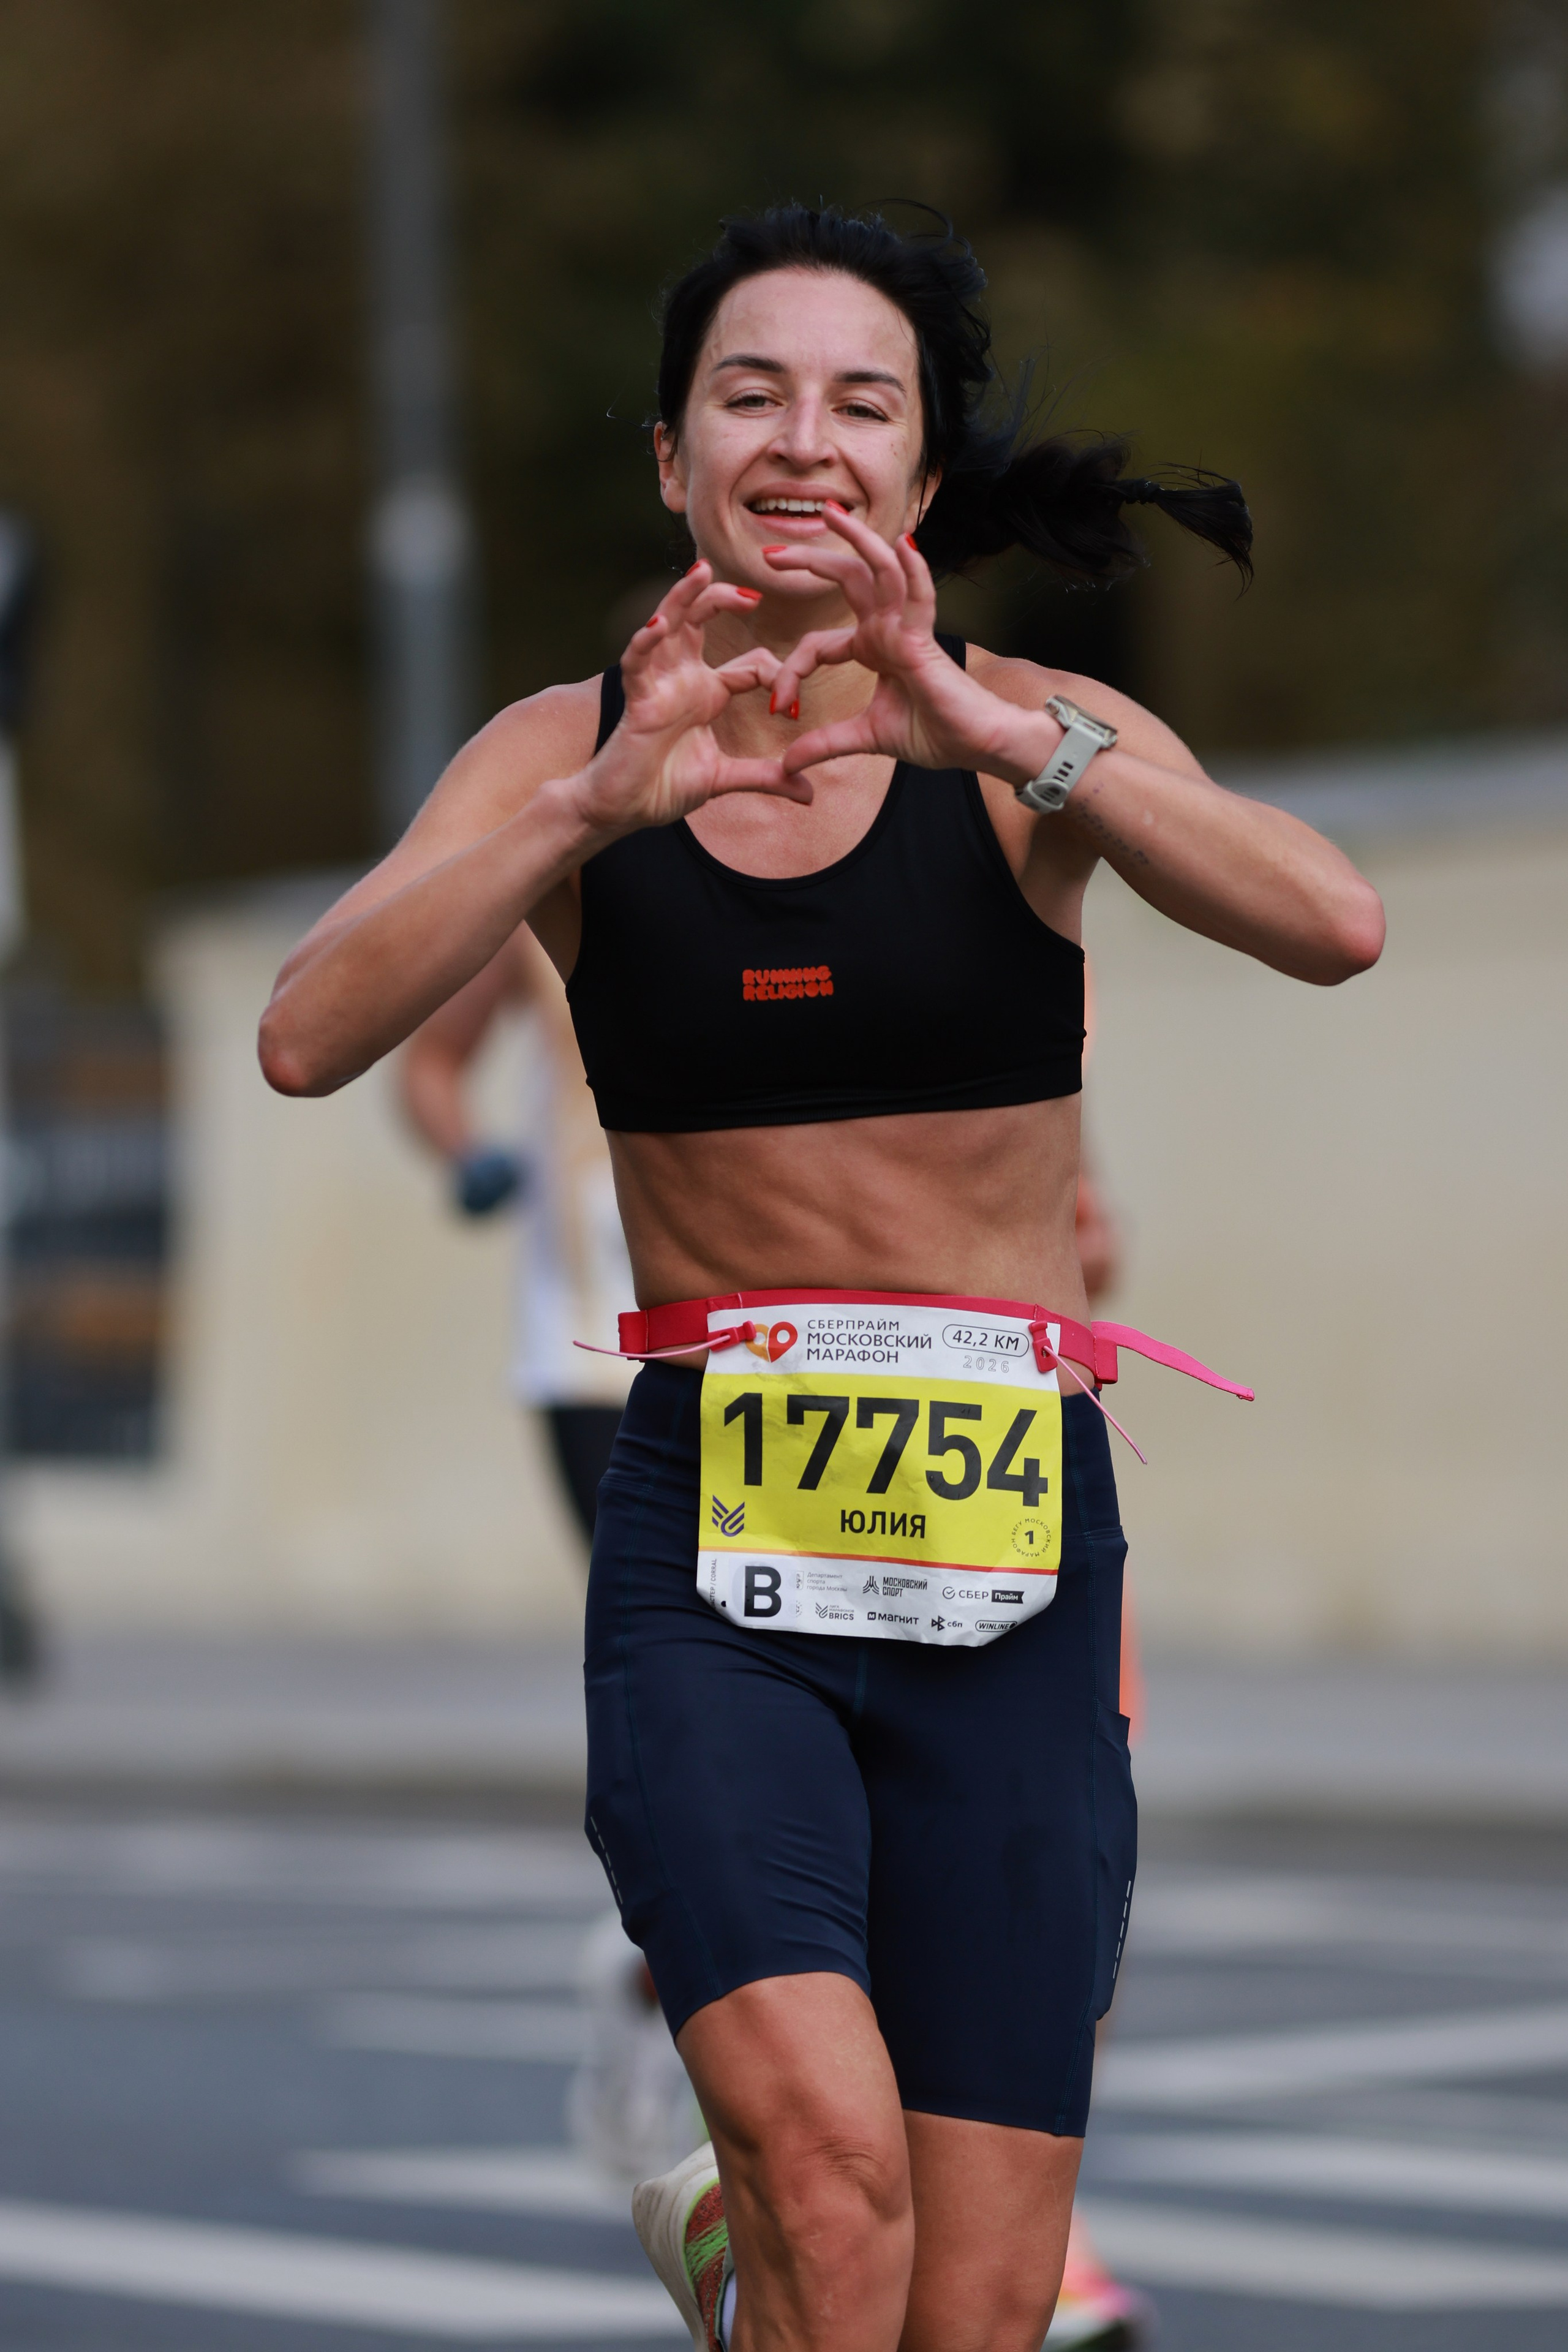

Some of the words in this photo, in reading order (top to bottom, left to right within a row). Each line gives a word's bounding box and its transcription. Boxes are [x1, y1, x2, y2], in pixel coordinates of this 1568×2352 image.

[742, 965, 832, 985] RUNNING
[743, 980, 834, 1001] RELIGION
[807, 1318, 899, 1331] СБЕРПРАЙМ
[807, 1333, 932, 1349] МОСКОВСКИЙ
[952, 1330, 988, 1347] 42,2
[807, 1348, 899, 1363] МАРАФОН
[963, 1355, 1009, 1373] 2026
[724, 1392, 1048, 1507] 17754
[840, 1509, 926, 1539] ЮЛИЯ
[1025, 1530, 1034, 1545] 1
[883, 1576, 928, 1591] МОСКОВСКИЙ
[883, 1586, 903, 1597] СПОРТ
[959, 1589, 989, 1599] СБЕР
[995, 1593, 1019, 1601] Прайм
[829, 1612, 854, 1621] BRICS
[878, 1613, 919, 1625] магнит
